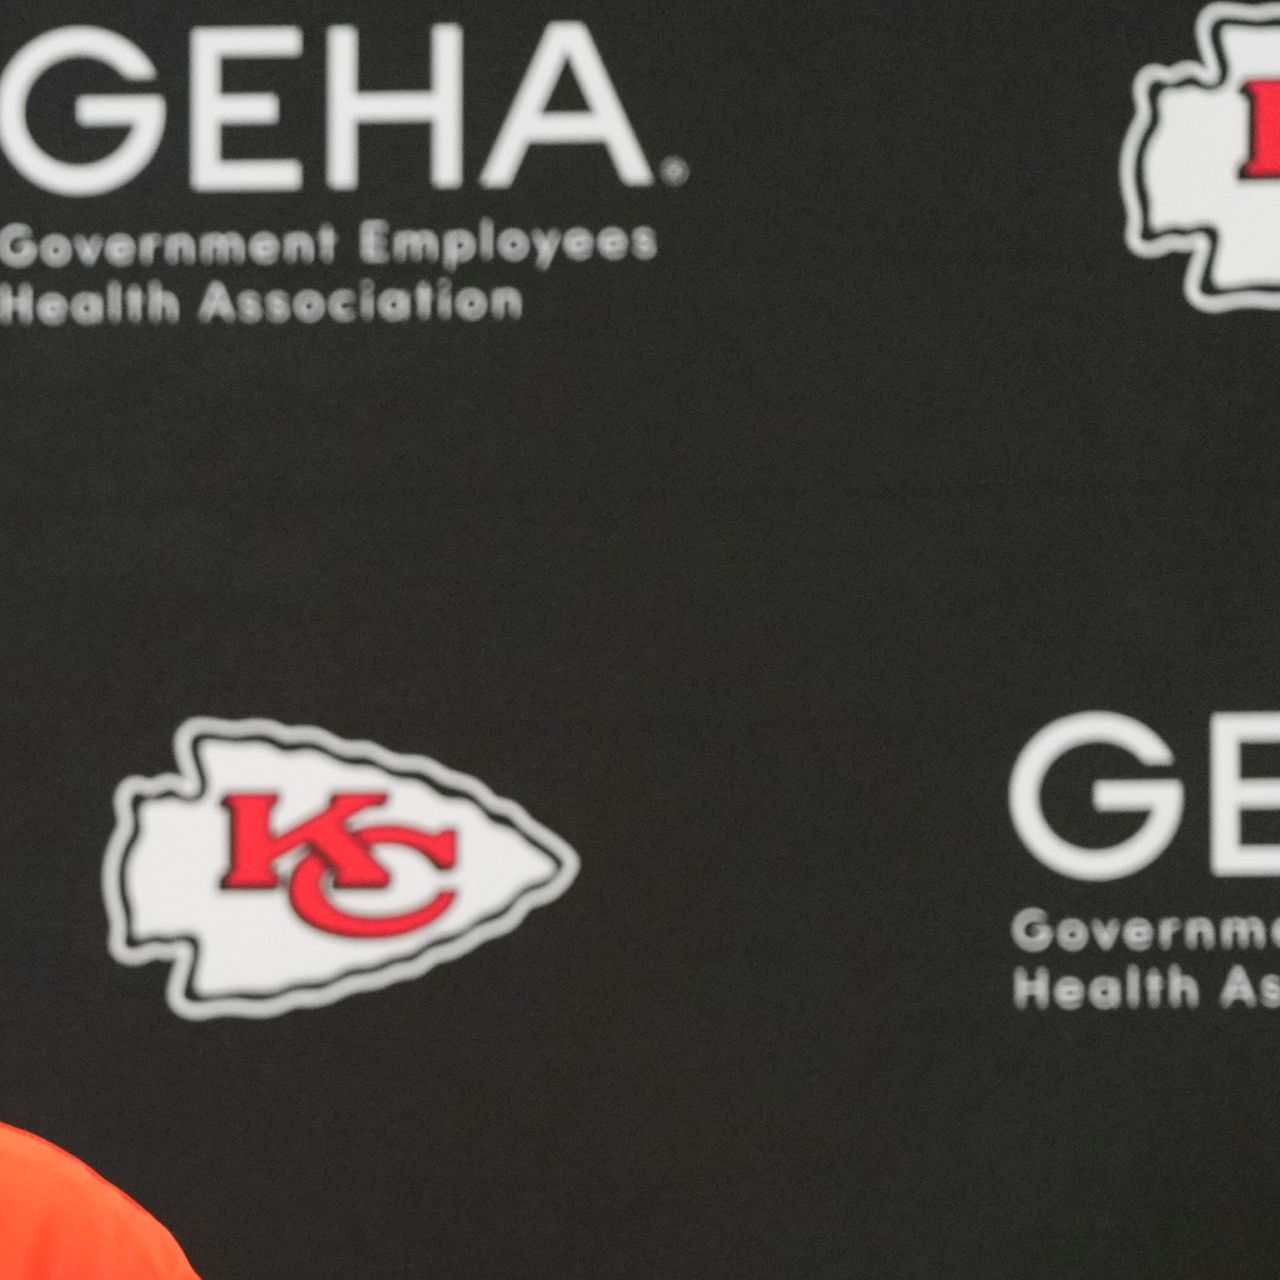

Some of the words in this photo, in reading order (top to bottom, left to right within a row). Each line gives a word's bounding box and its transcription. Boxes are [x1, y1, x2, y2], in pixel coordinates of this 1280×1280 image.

[357, 216, 659, 272] Employees
[196, 276, 524, 325] Association
[221, 790, 459, 940] KC
[1009, 905, 1280, 954] Governm
[1012, 962, 1201, 1012] Health
